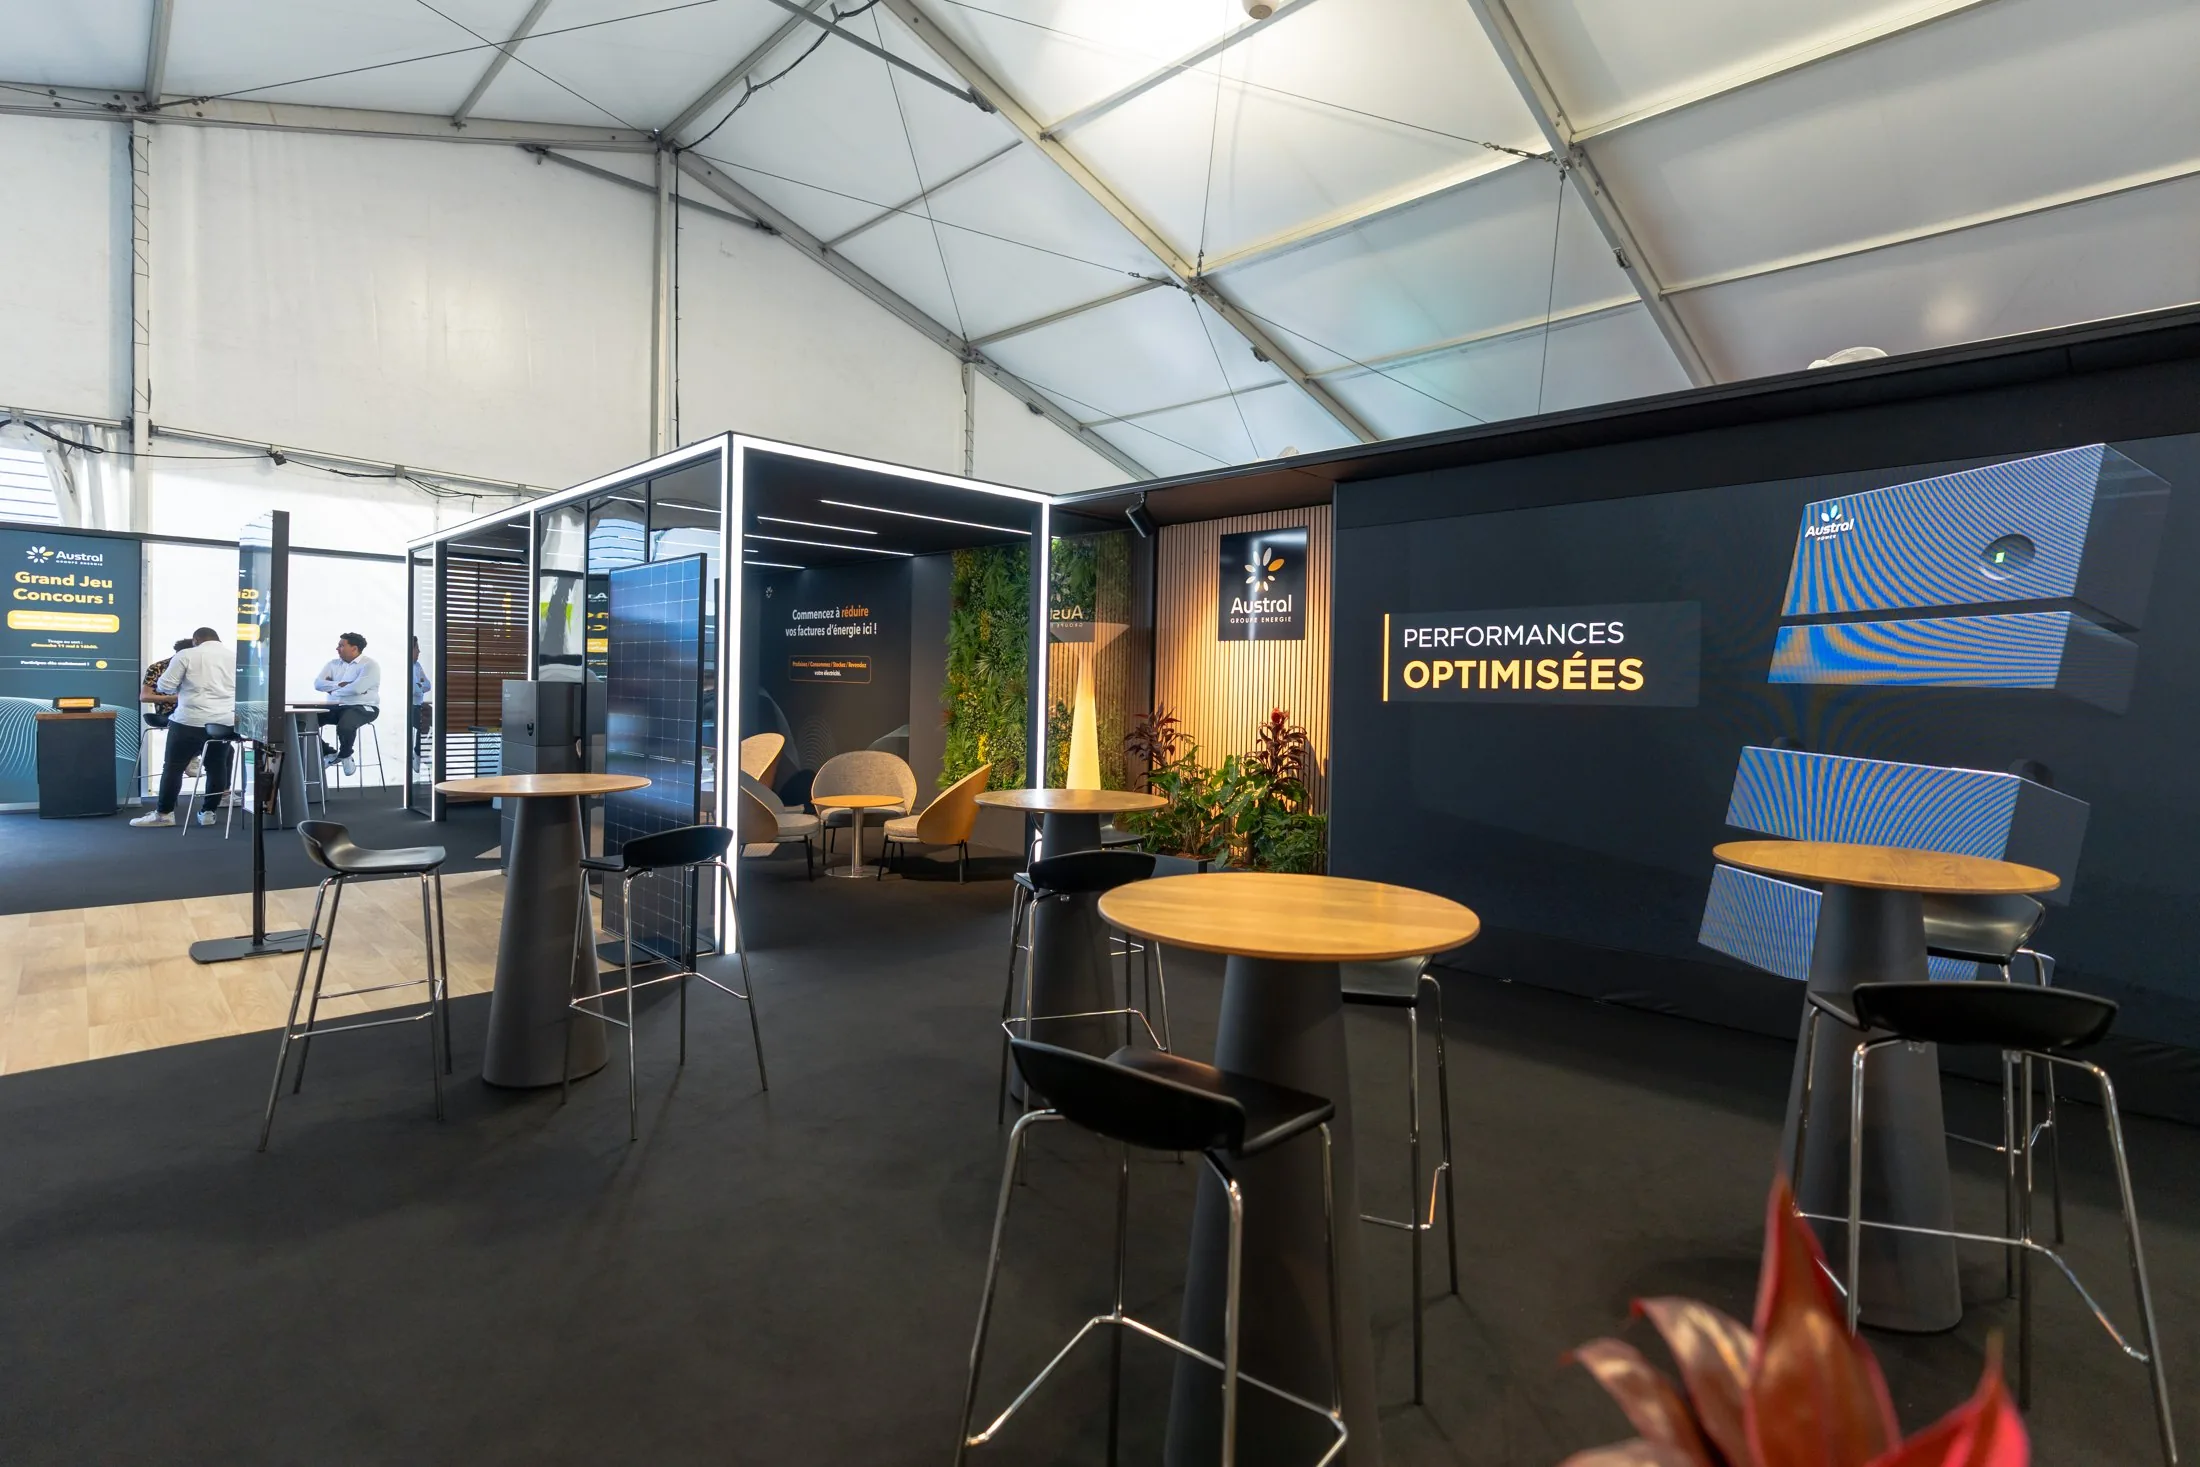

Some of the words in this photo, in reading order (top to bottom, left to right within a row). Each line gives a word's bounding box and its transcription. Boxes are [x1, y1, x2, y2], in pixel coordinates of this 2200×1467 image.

[1804, 518, 1855, 538] Austral
[56, 551, 103, 562] Austral
[14, 571, 75, 586] Grand
[79, 575, 113, 588] Jeu
[13, 588, 104, 604] Concours
[108, 593, 114, 605] !
[1230, 594, 1292, 614] Austral
[792, 609, 835, 620] Commencez
[835, 607, 840, 618] à
[841, 605, 869, 618] réduire
[785, 628, 797, 637] vos
[797, 625, 825, 636] factures
[826, 623, 861, 638] d'énergie
[863, 622, 872, 635] ici
[1404, 621, 1625, 648] PERFORMANCES
[1403, 650, 1645, 691] OPTIMISÉES
